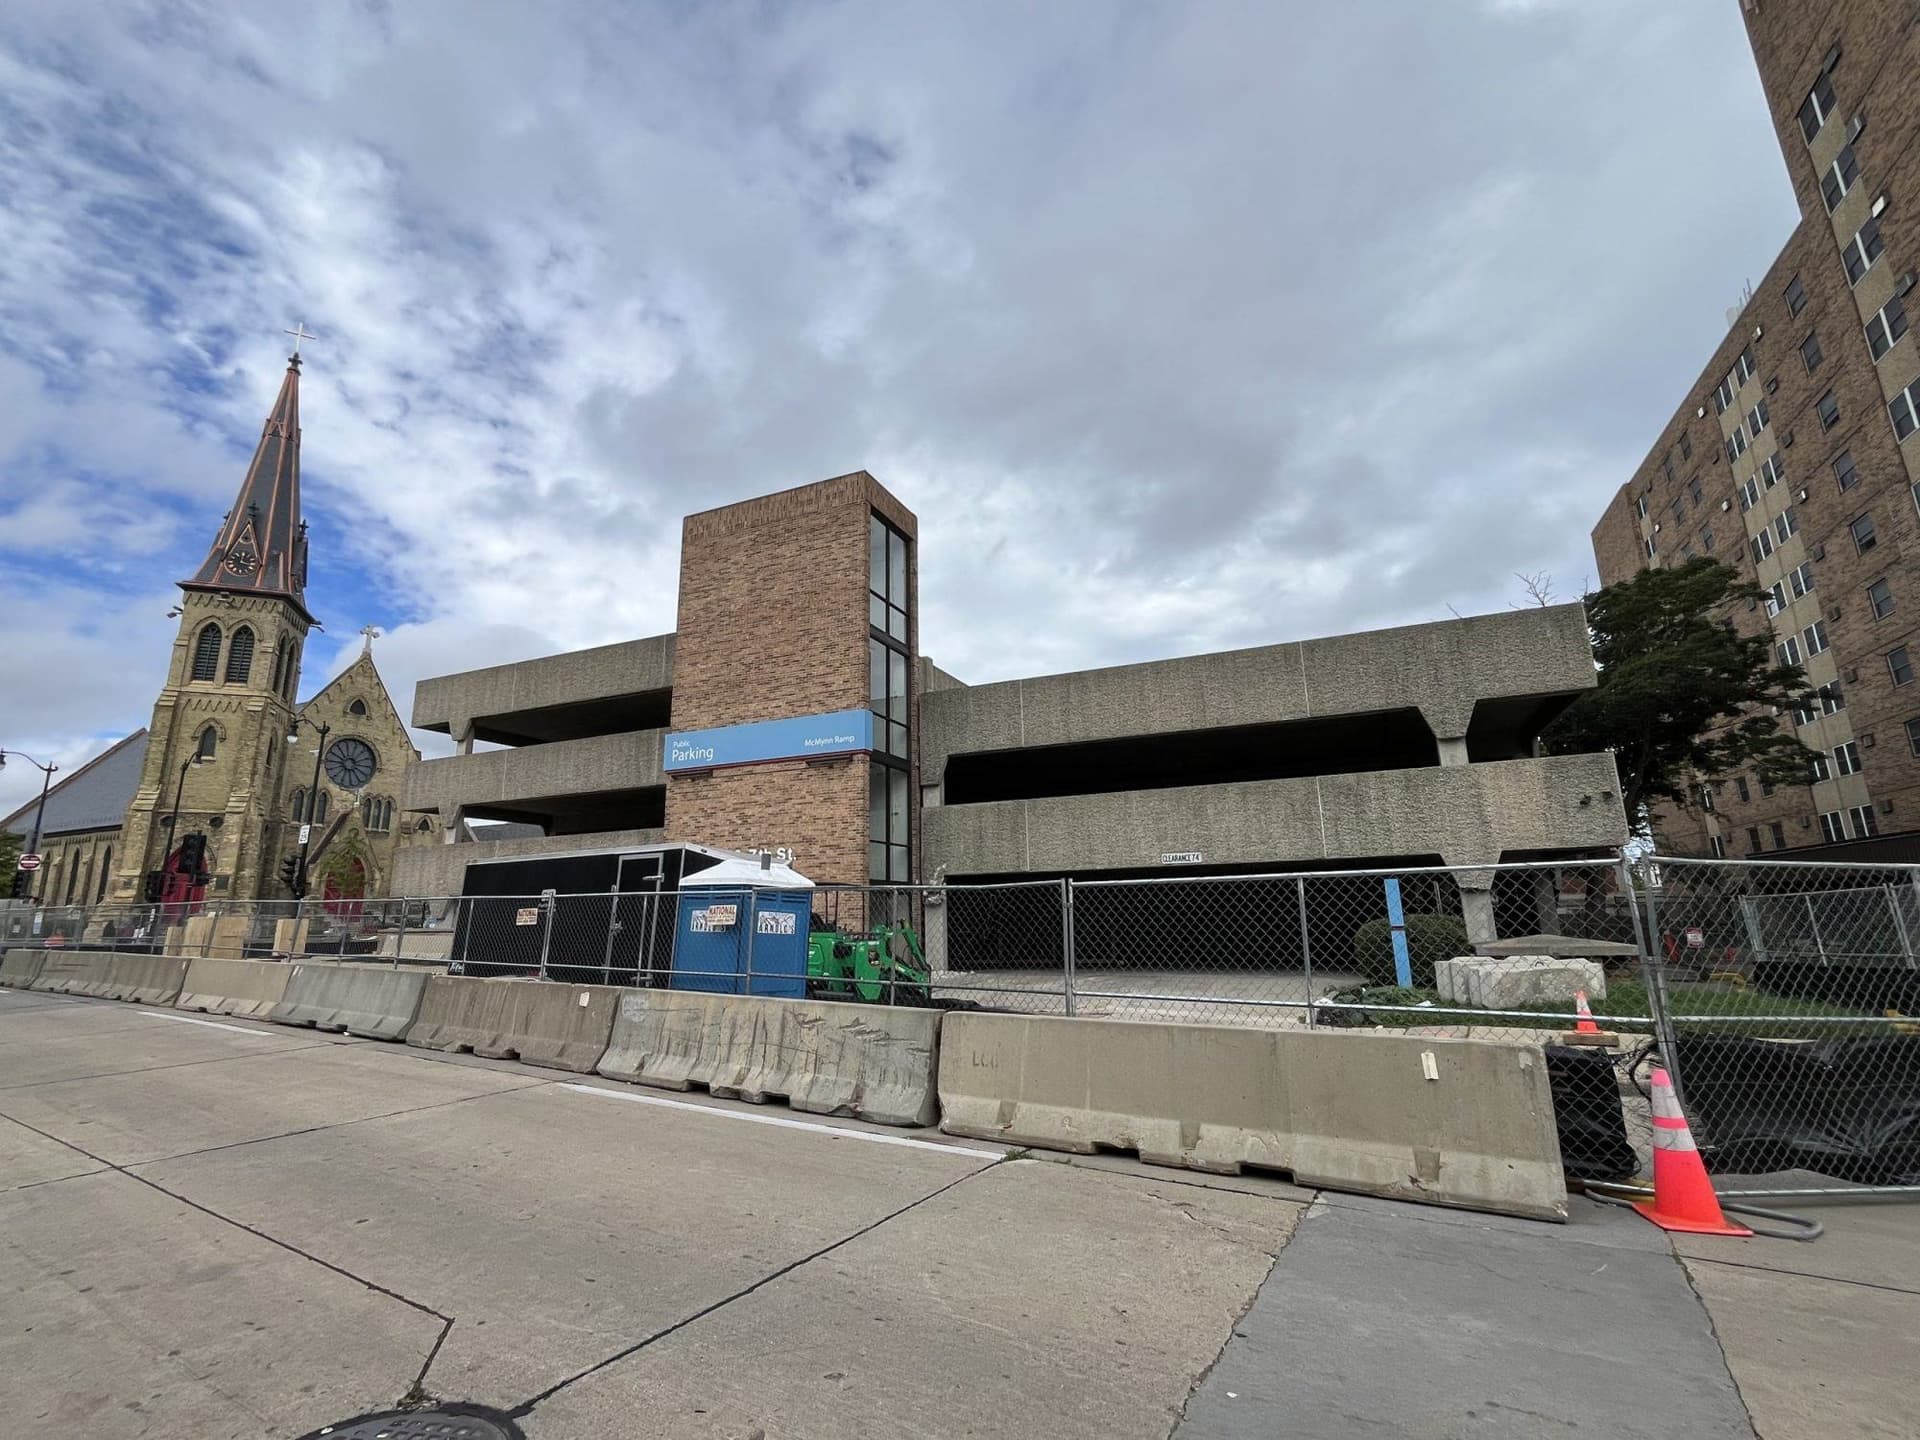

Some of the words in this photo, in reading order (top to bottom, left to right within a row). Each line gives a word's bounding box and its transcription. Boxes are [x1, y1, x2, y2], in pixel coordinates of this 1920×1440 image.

[673, 740, 690, 748] Public
[804, 737, 834, 747] McMynn
[834, 735, 856, 744] Ramp
[672, 747, 714, 762] Parking
[1162, 854, 1191, 863] CLEARANCE
